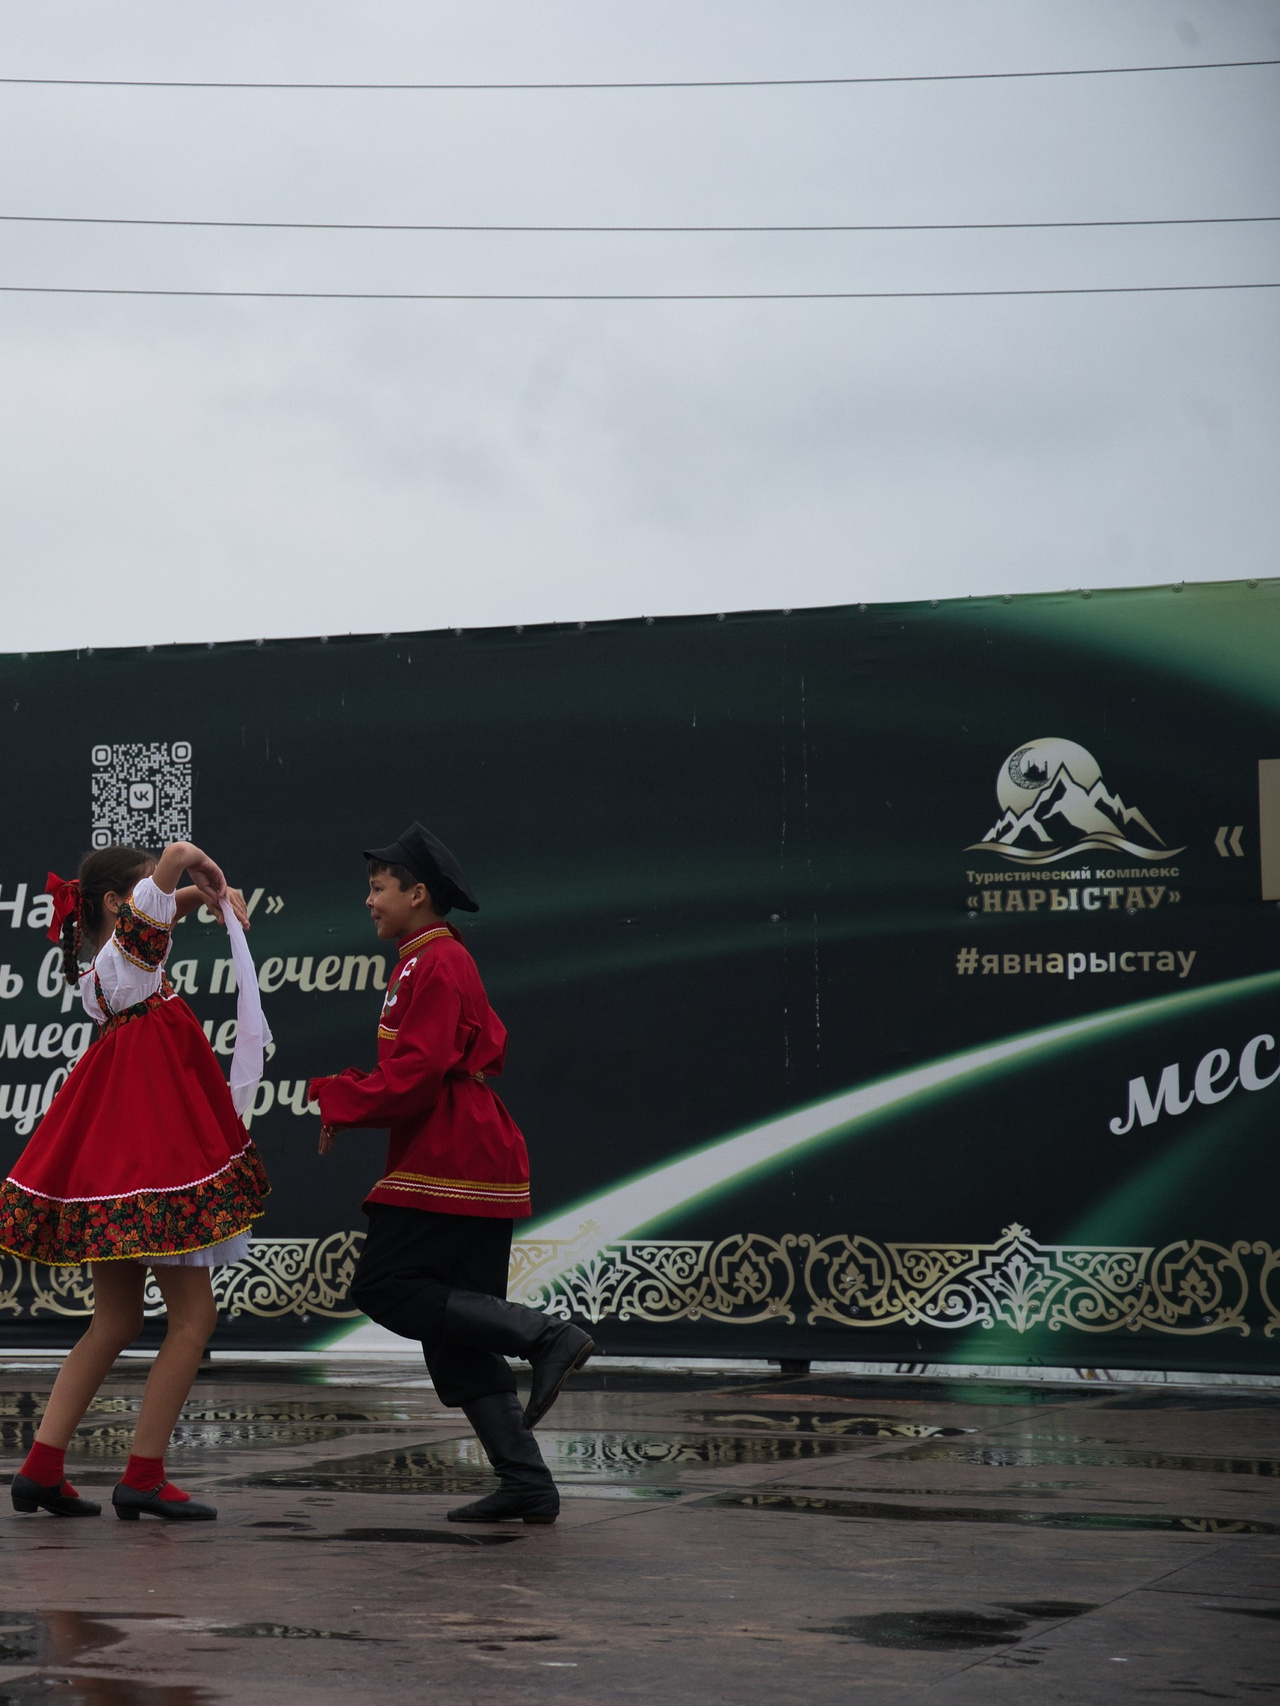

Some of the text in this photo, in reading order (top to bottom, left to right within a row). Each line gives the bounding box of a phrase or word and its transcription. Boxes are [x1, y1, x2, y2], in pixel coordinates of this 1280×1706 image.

[966, 866, 1180, 885] Туристический комплекс
[967, 886, 1182, 913] «НАРЫСТАУ»
[209, 954, 388, 995] течет
[956, 948, 1197, 980] #явнарыстау
